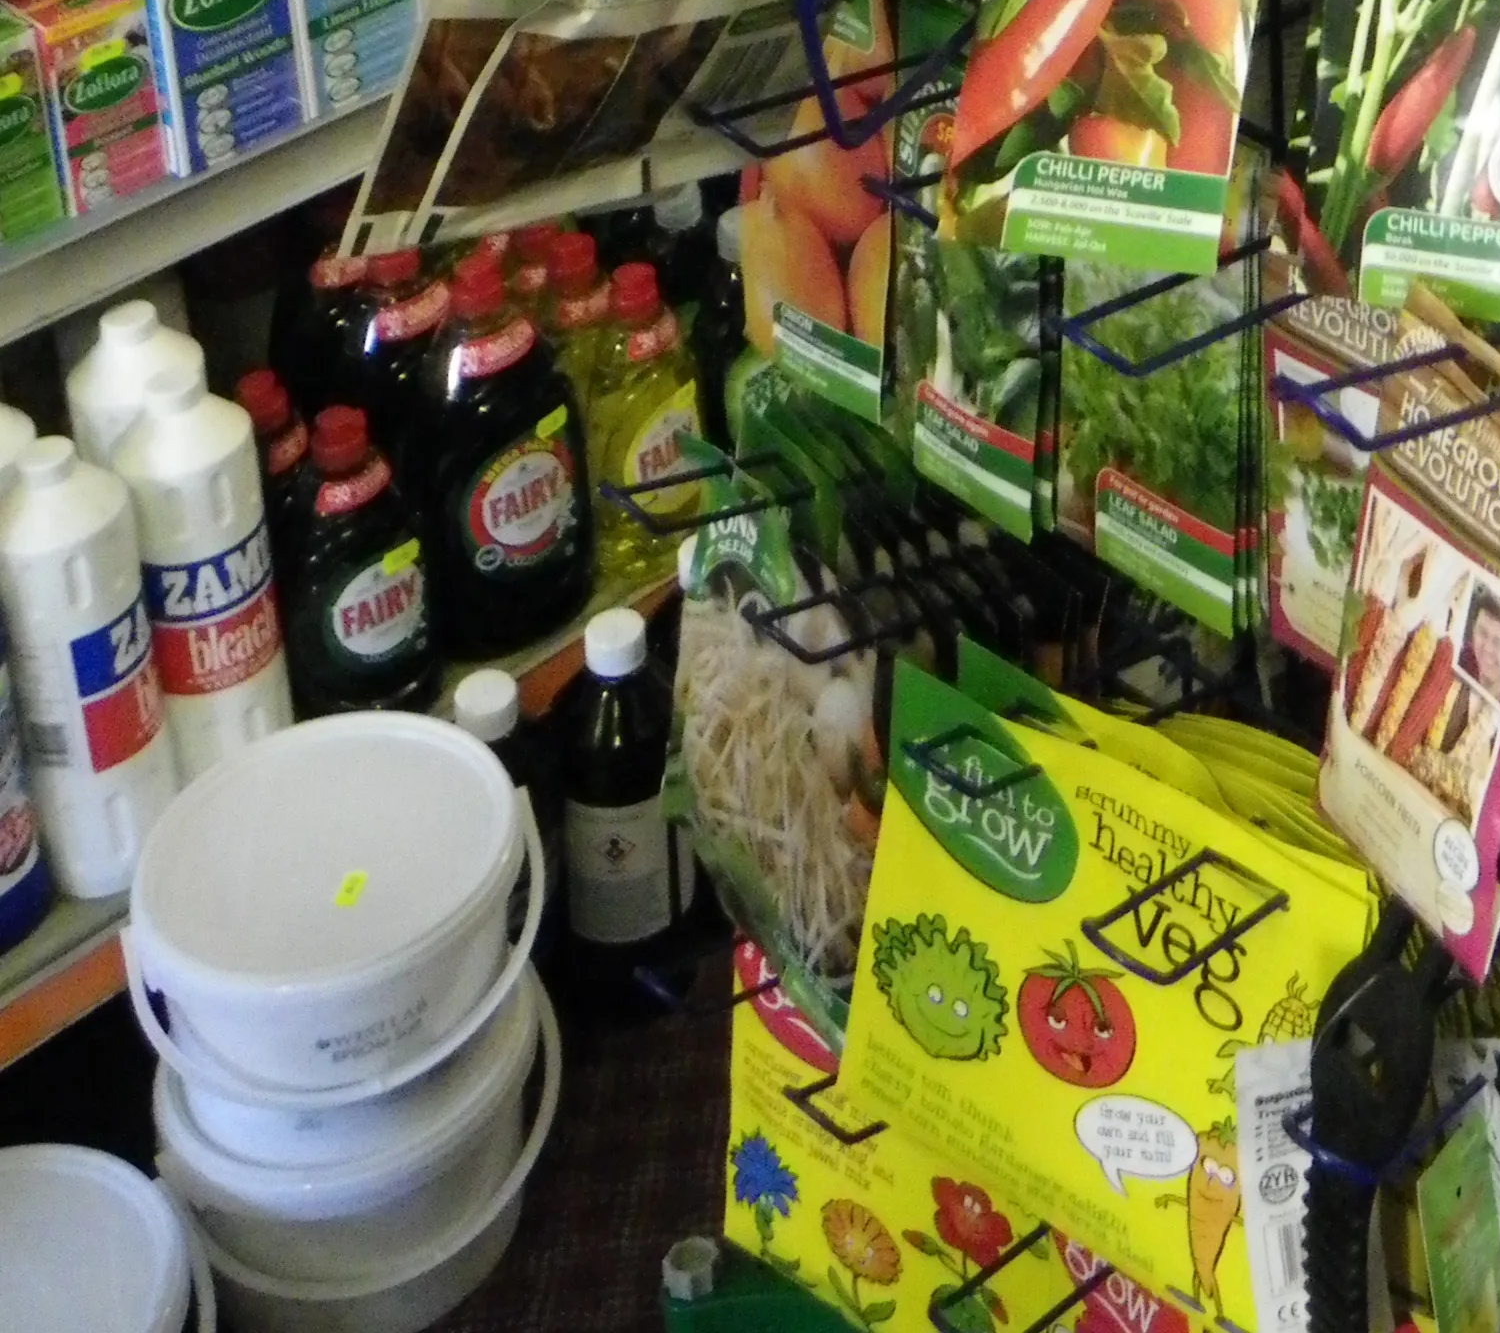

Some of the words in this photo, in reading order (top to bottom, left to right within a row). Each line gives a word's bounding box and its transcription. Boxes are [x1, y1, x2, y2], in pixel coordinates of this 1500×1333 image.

[73, 62, 140, 101] Zoflora
[1036, 157, 1095, 181] CHILLI
[1097, 164, 1167, 191] PEPPER
[1386, 213, 1444, 238] CHILLI
[487, 464, 563, 526] FAIRY
[342, 577, 418, 636] FAIRY
[923, 769, 1053, 867] grow
[1022, 792, 1055, 828] to
[1075, 785, 1193, 860] scrummy
[1088, 811, 1244, 936] healthy
